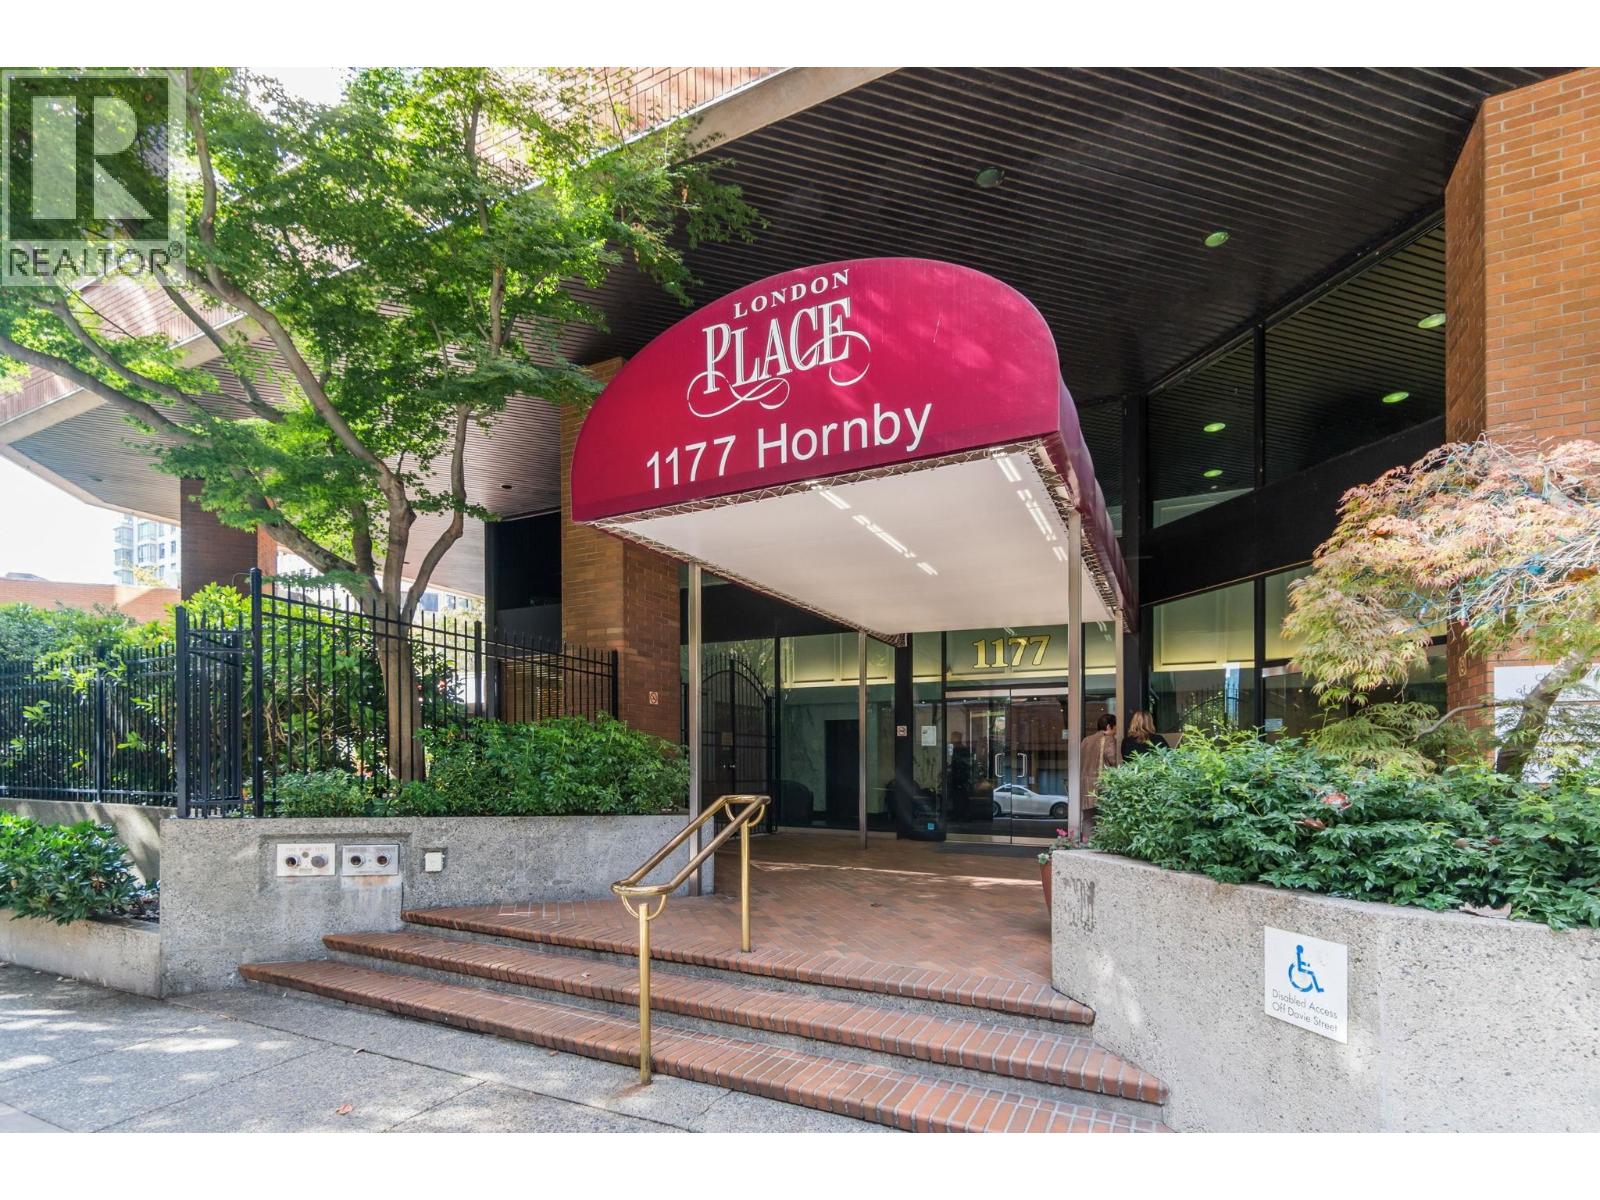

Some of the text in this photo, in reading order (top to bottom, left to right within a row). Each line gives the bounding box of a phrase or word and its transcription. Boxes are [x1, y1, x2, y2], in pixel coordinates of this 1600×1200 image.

[733, 269, 850, 319] LONDON
[702, 297, 851, 394] PLACE
[646, 403, 932, 489] 1177 Hornby
[973, 635, 1050, 669] 1177
[1271, 1001, 1338, 1032] Off Davie Street
[1272, 989, 1338, 1020] Disabled Access
